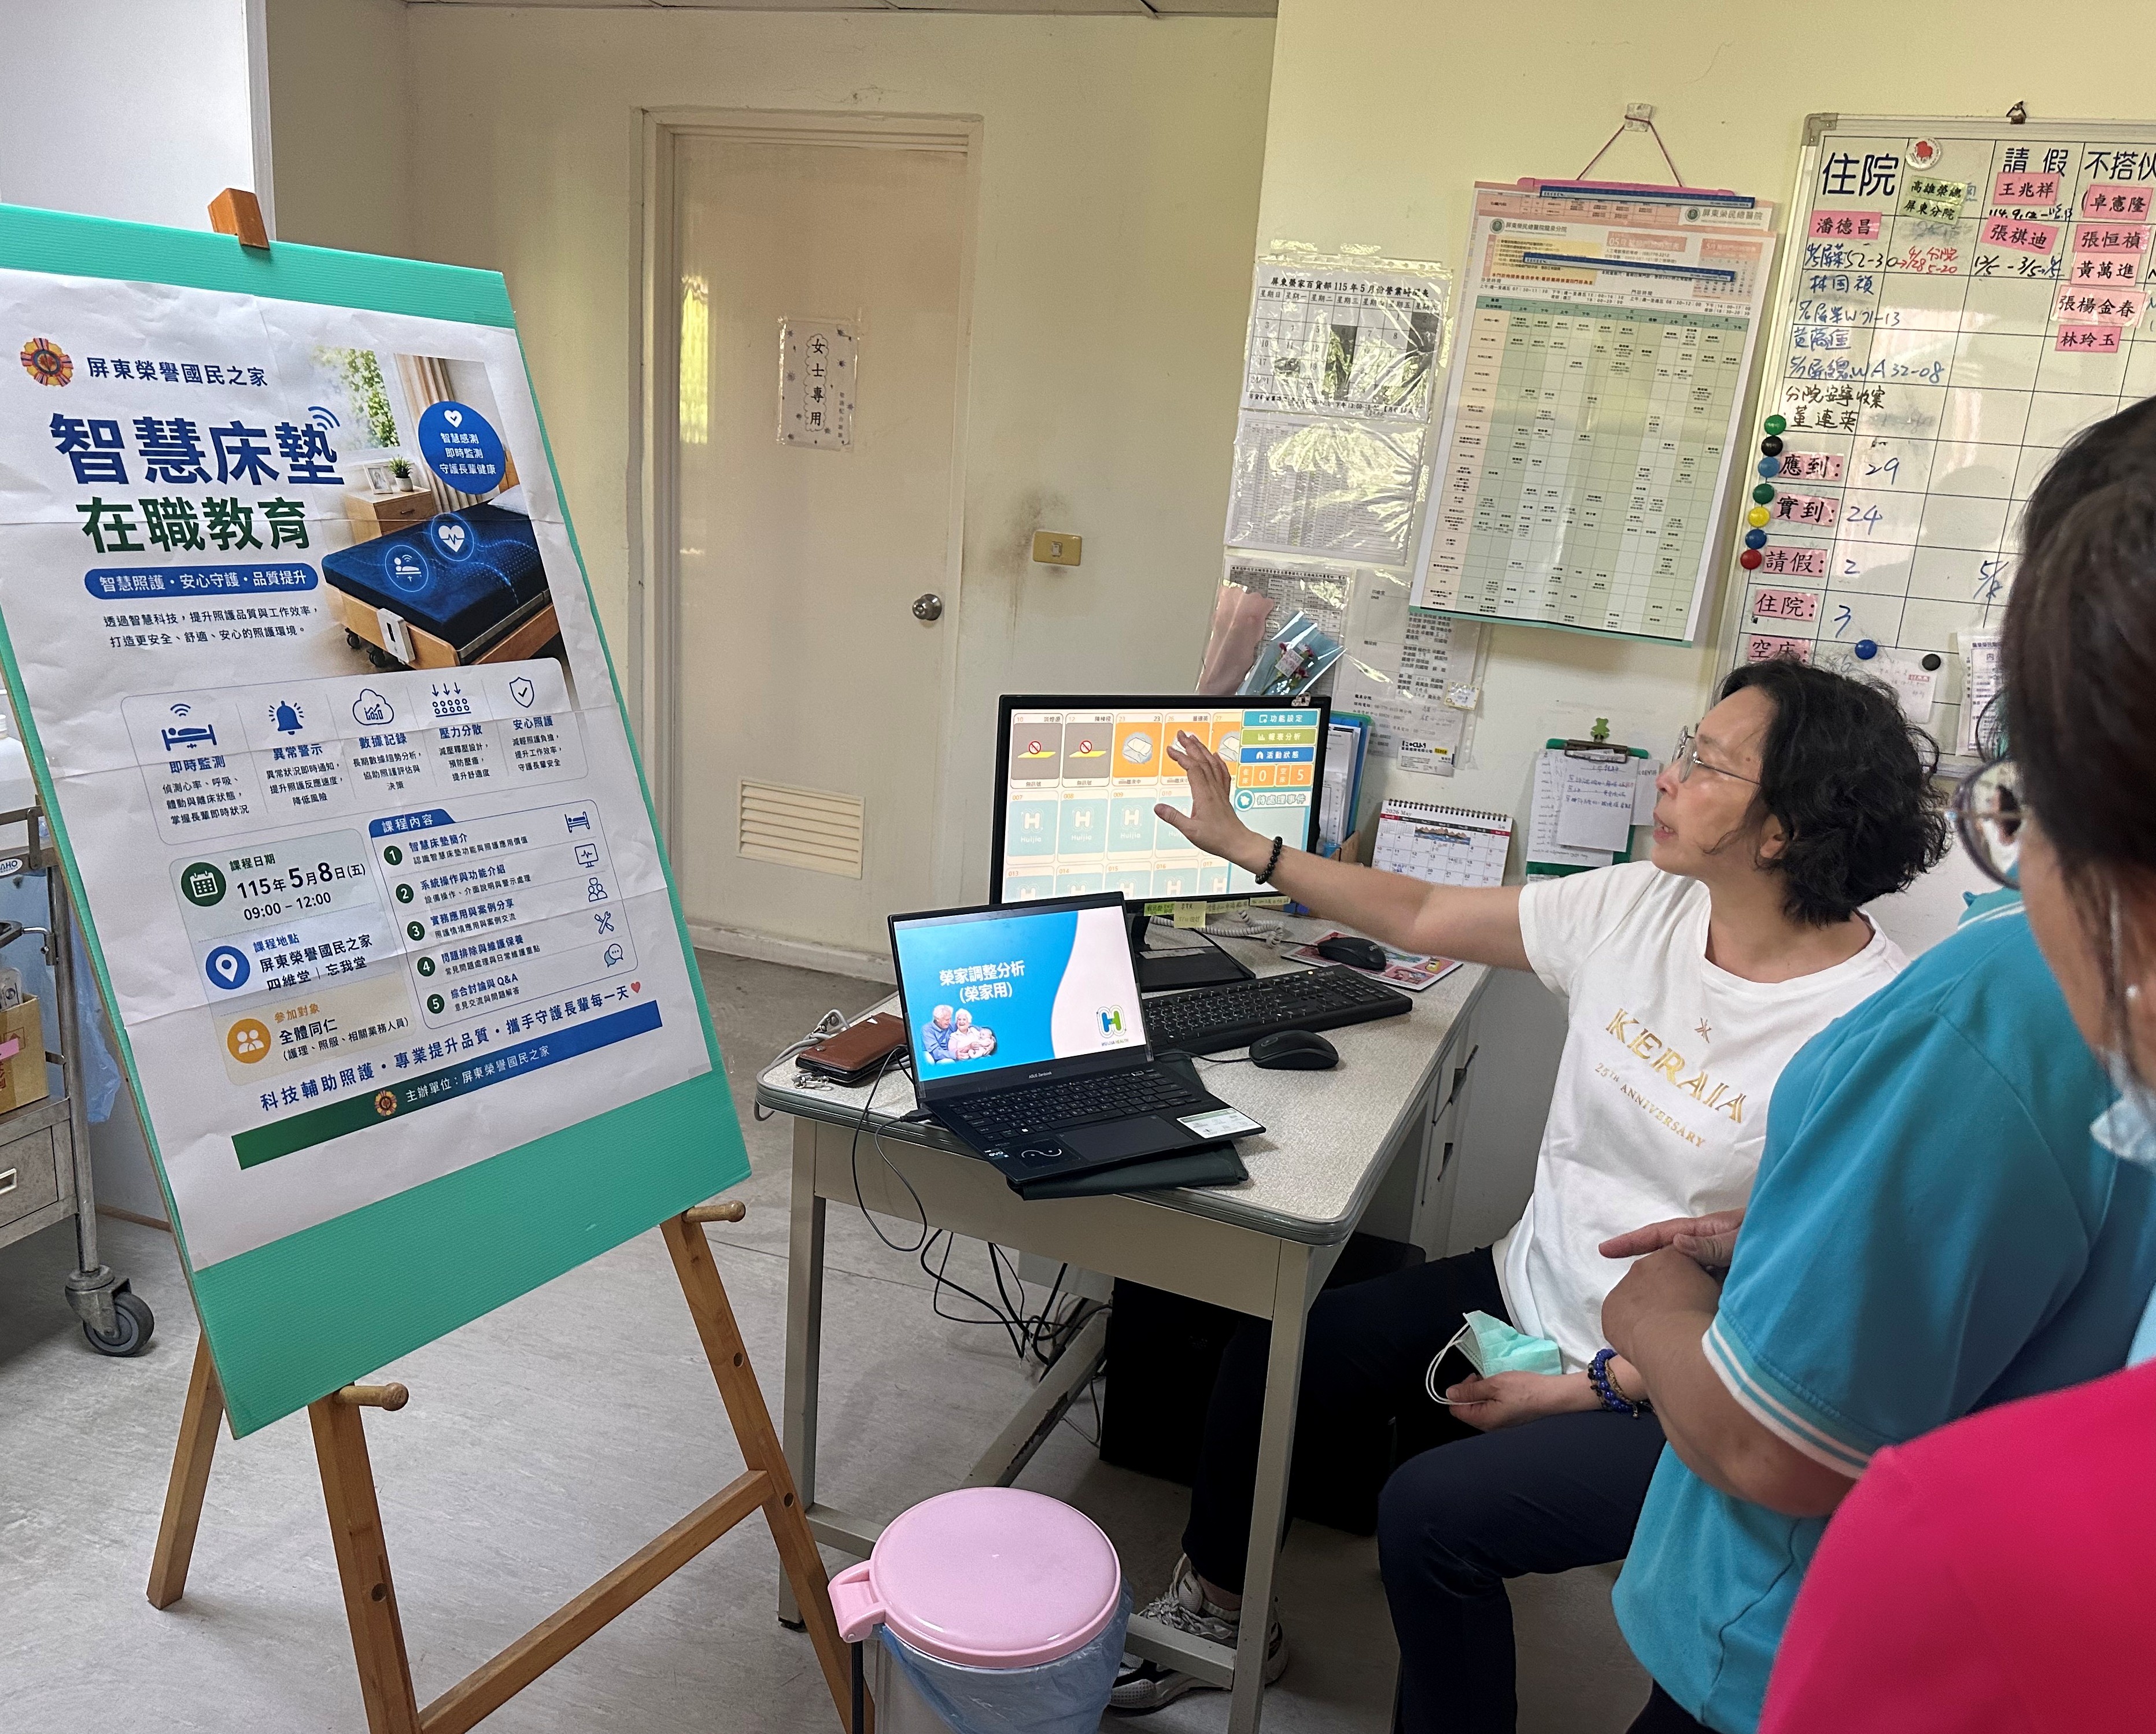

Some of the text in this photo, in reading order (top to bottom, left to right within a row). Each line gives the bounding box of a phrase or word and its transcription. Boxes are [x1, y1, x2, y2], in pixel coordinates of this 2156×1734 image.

[1822, 153, 1899, 196] 住院
[2084, 151, 2156, 181] 不搭伙
[1998, 182, 2054, 198] 王兆祥
[1904, 199, 1955, 220] 屏東分院
[2090, 195, 2147, 213] 卓憲隆
[1702, 209, 1763, 220] 屏東榮民總醫院
[1817, 217, 1871, 235] 潘德昌
[1990, 224, 2047, 249] 張祺迪
[2077, 260, 2135, 279] 黃萬進
[1271, 276, 1332, 290] 屏東榮家百貨部
[1334, 282, 1348, 291] 115
[1350, 283, 1358, 292] 年
[1337, 296, 1359, 304] 星期三
[2058, 295, 2135, 317] 張楊金春
[1261, 340, 1269, 348] 10
[1393, 332, 1398, 340] 8
[2060, 331, 2115, 347] 林玲玉
[1259, 358, 1267, 366] 17
[86, 357, 268, 387] 屏東榮譽國民之家
[810, 338, 826, 426] 女士專用
[440, 432, 479, 444] 智慧感測
[49, 413, 344, 485] 智慧床墊
[445, 448, 483, 459] 即時監測
[440, 463, 496, 475] 守護長輩健康
[1865, 457, 1900, 485] 29
[75, 497, 311, 554] 在職教育
[1846, 505, 1883, 535] 24
[1845, 560, 1860, 575] 2
[104, 606, 318, 628] 透過智慧科技，提升照護品質與工作效率，
[1834, 605, 1851, 638] 3
[110, 624, 305, 648] 打造更安全、舒適、安心的照護環境。
[439, 724, 482, 740] 壓力分散
[513, 716, 553, 730] 安心照護
[359, 732, 407, 750] 數據記錄
[1268, 733, 1301, 741] 報表分析
[273, 743, 323, 761] 異常警示
[1266, 751, 1299, 759] 活動狀態
[169, 755, 226, 774] 即時監測
[518, 759, 561, 771] 守護長輩安全
[452, 768, 490, 782] 提升舒適度
[1259, 770, 1267, 782] 0
[1297, 769, 1304, 781] 5
[386, 781, 404, 790] 決策
[292, 793, 328, 806] 降低風險
[1257, 794, 1306, 805] 待處理事件
[171, 804, 249, 825] 掌握長輩即時狀況
[382, 813, 434, 834] 課程內容
[409, 833, 467, 852] 智慧床墊簡介
[229, 853, 276, 871] 課程日期
[420, 864, 506, 890] 系統操作與功能介紹
[401, 888, 408, 900] 2
[424, 874, 531, 904] 設備操作、介面說明與警示處理
[243, 892, 331, 920] 09:00 12:00
[430, 898, 514, 926] 實務應用與案例分享
[412, 926, 420, 937] 3
[252, 933, 300, 953] 課程地點
[441, 934, 523, 964] 問題排除與維護保養
[259, 934, 373, 973] 屏東榮譽國民之家
[445, 945, 540, 975] 常見問題處理與日常維護重點
[422, 961, 430, 972] 4
[939, 960, 1025, 986] 榮家調整分析
[451, 973, 518, 1000] 綜合討論與 Q&A
[959, 982, 1013, 1004] (榮家用)
[433, 998, 440, 1009] 5
[455, 986, 519, 1012] 意見交流與問題解答
[274, 1003, 320, 1023] 參加對象
[279, 1018, 338, 1045] 全體同仁
[406, 1045, 550, 1103] 主辦單位：屏東榮譽國民之家
[1605, 1008, 1747, 1123] KERAIA
[1595, 1063, 1705, 1148] 25TH ANNIVERSARY
